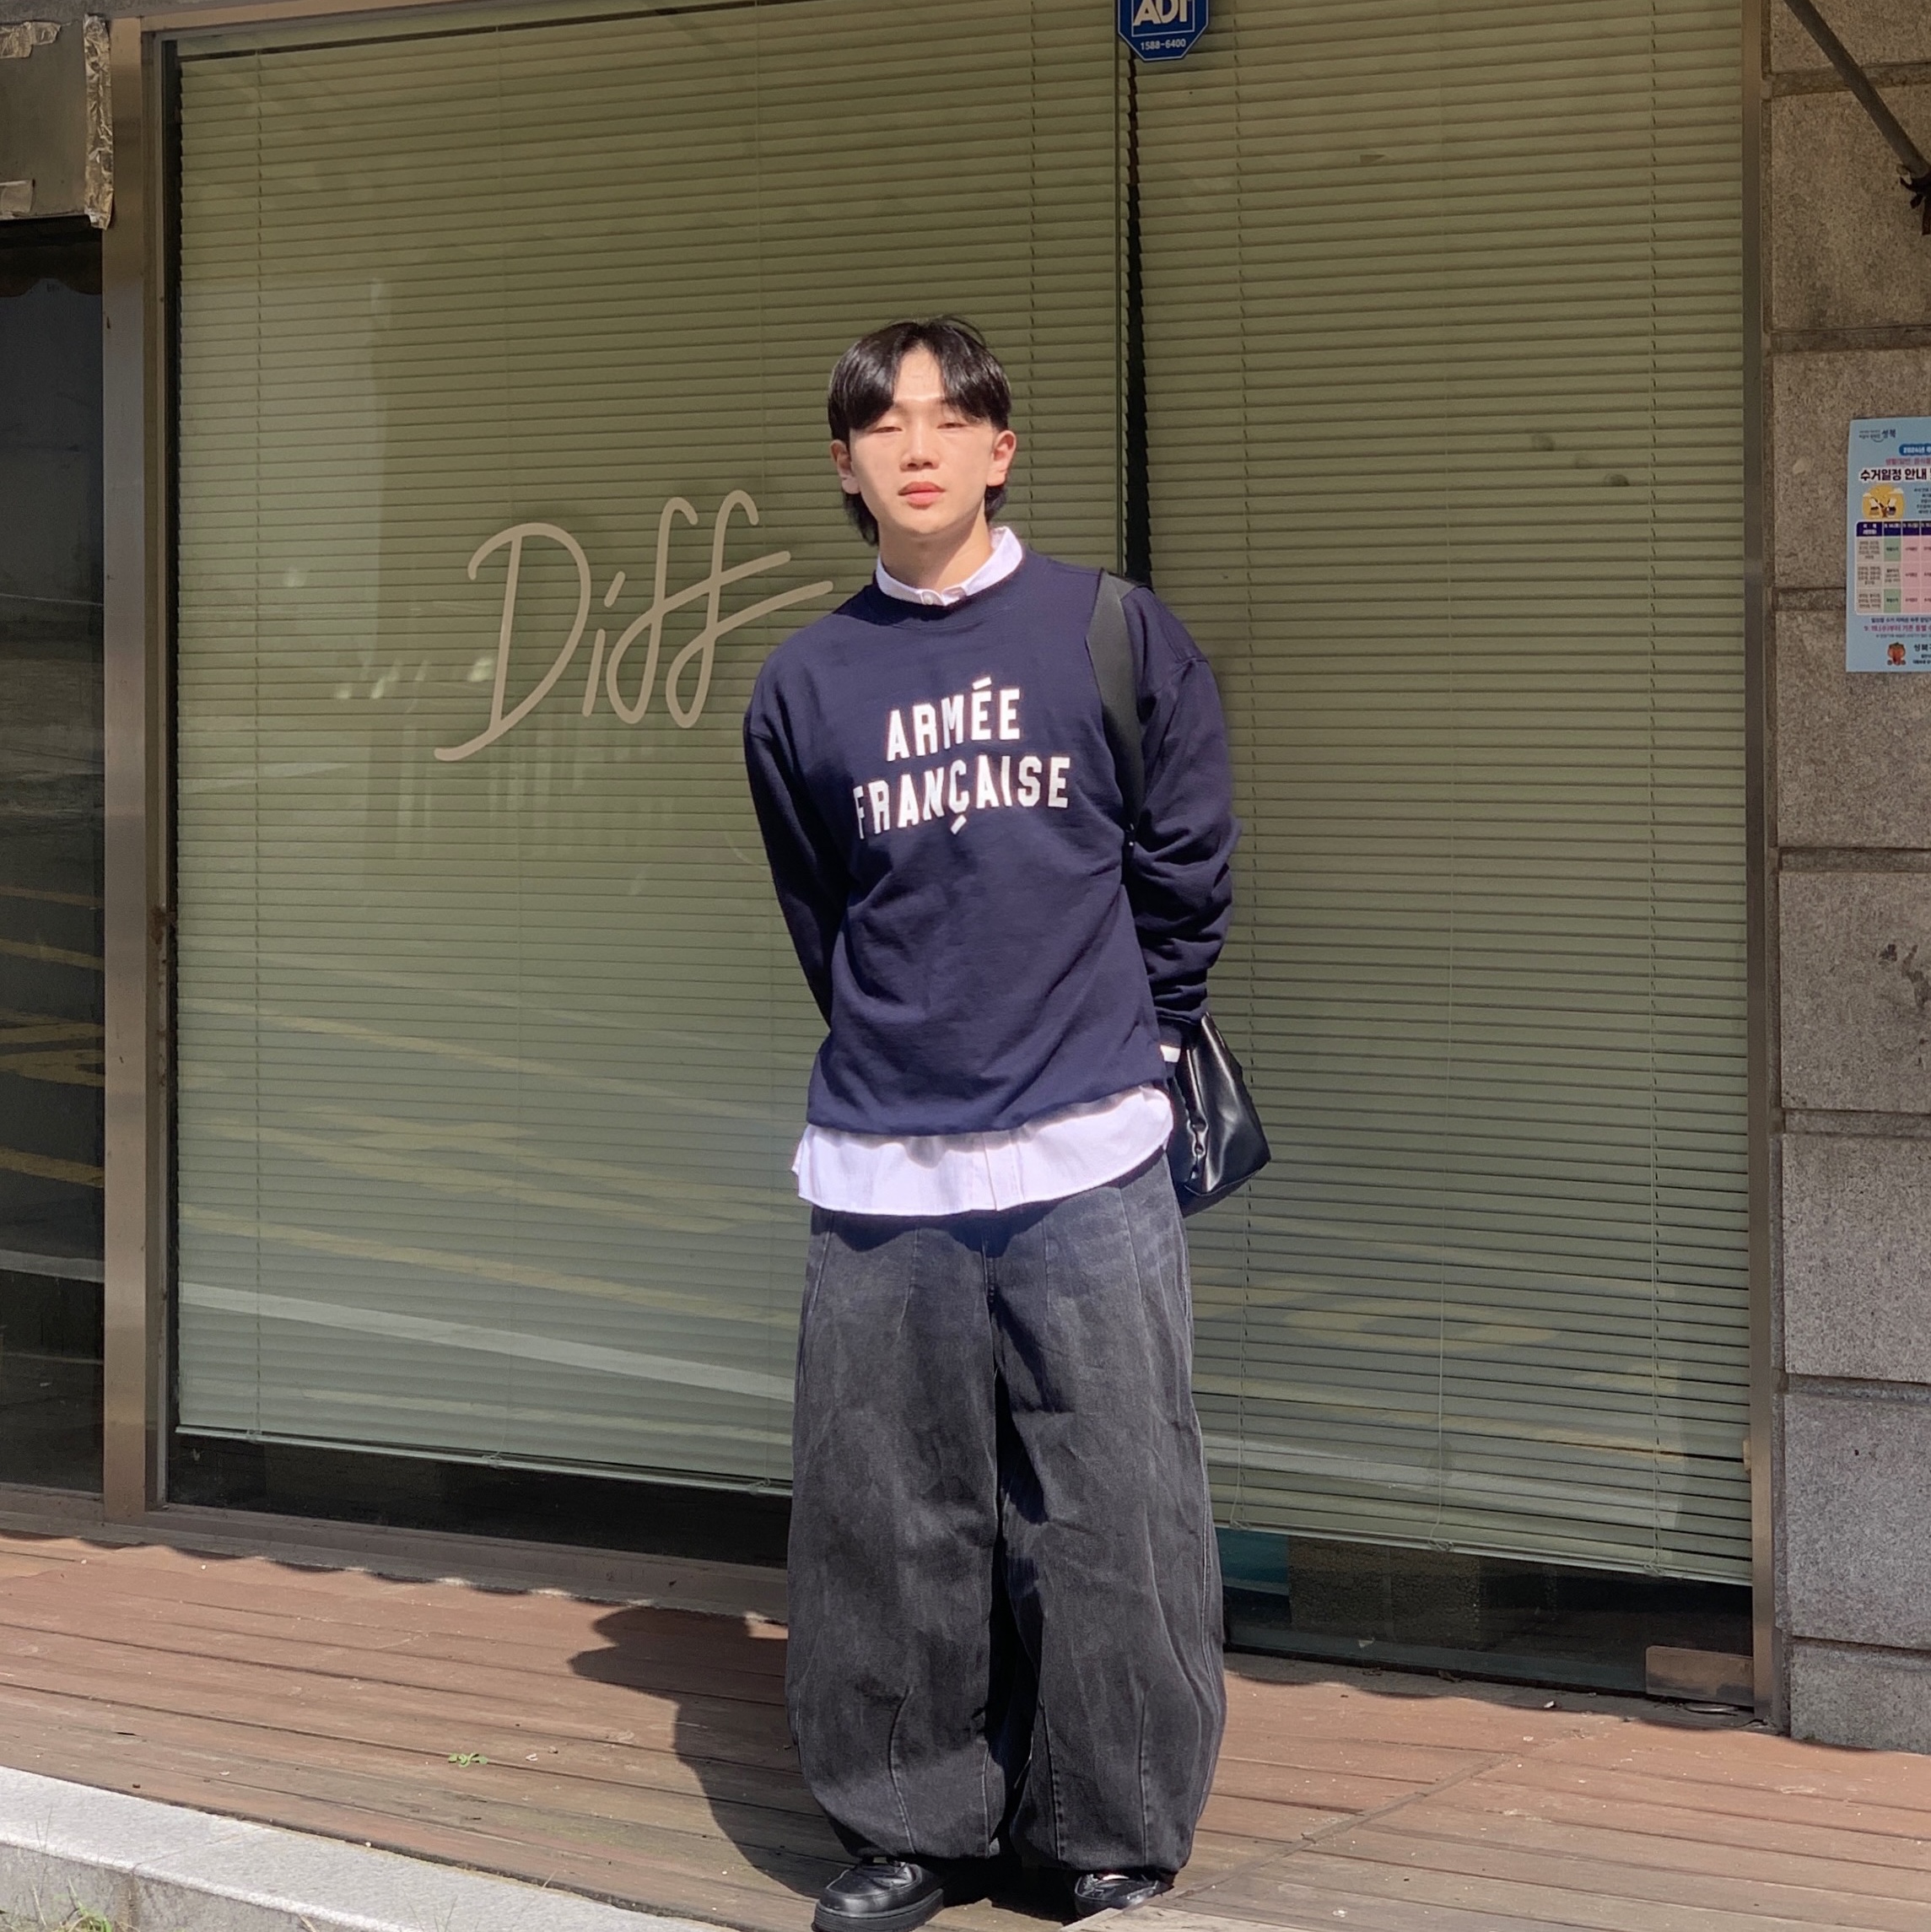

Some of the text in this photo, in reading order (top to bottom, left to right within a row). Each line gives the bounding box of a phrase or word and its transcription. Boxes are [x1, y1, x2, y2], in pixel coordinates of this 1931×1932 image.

[1141, 39, 1187, 51] 1588-6400
[1860, 468, 1901, 482] 수거일정
[1904, 467, 1927, 480] 안내
[434, 489, 833, 761] Diff
[887, 677, 1020, 762] ARMÉE
[853, 755, 1071, 839] FRANÇAISE
